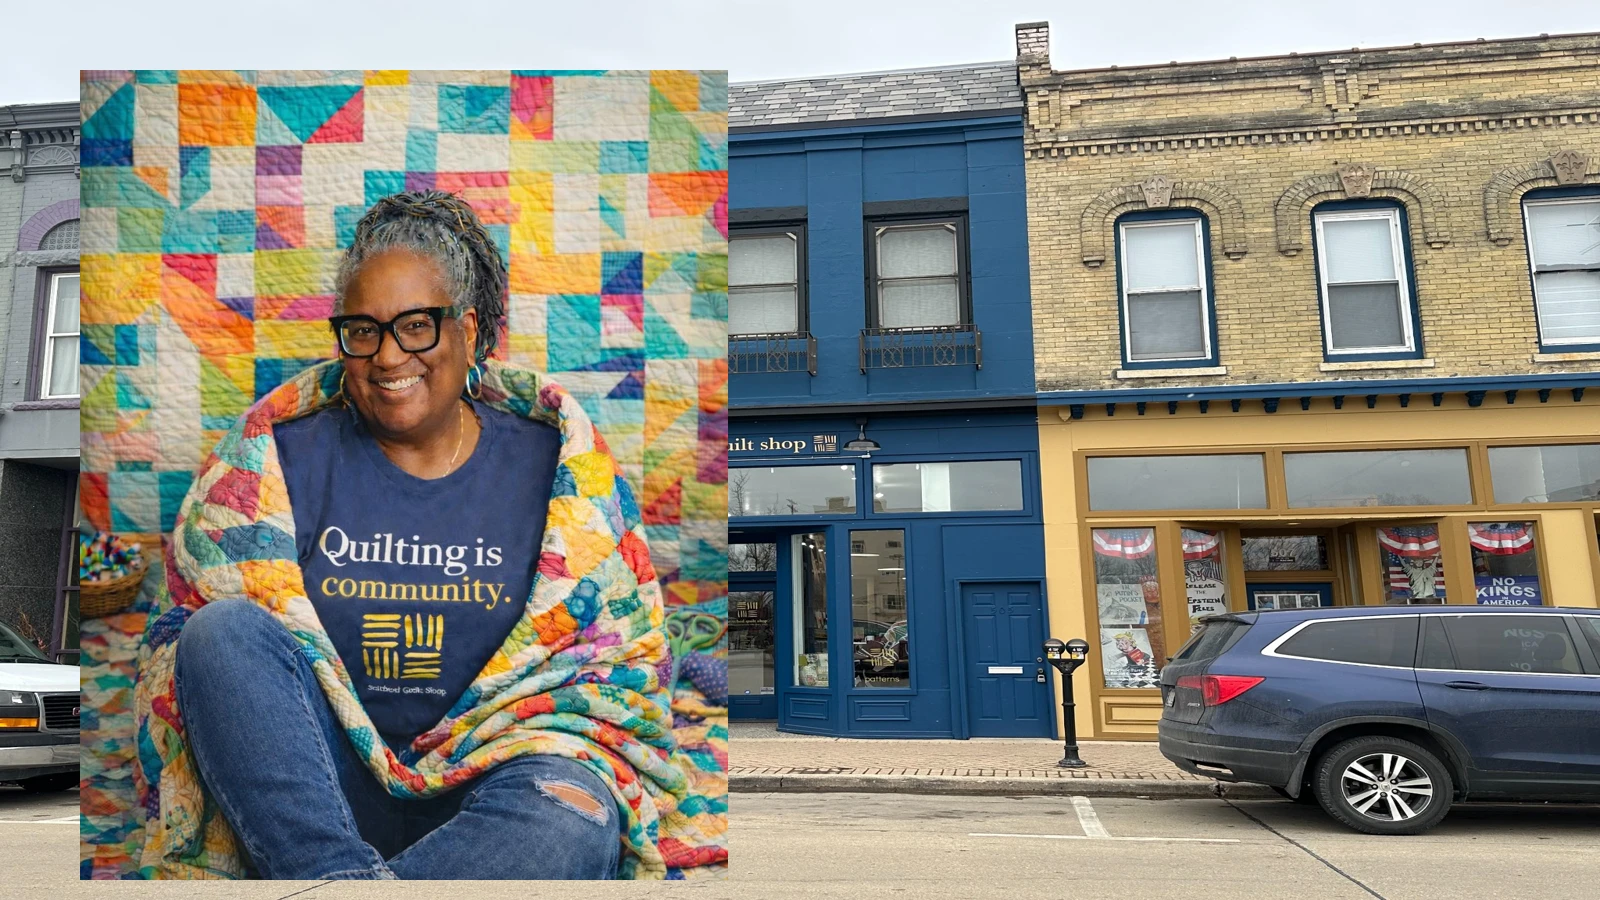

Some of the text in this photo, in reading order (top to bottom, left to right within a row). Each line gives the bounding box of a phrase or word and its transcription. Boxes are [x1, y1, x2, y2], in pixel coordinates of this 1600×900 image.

[728, 437, 807, 453] uilt shop
[319, 526, 503, 577] Quilting is
[1492, 577, 1515, 586] NO
[321, 576, 512, 610] community.
[1476, 585, 1536, 598] KINGS
[1192, 604, 1215, 614] FILES
[864, 675, 900, 686] patterns
